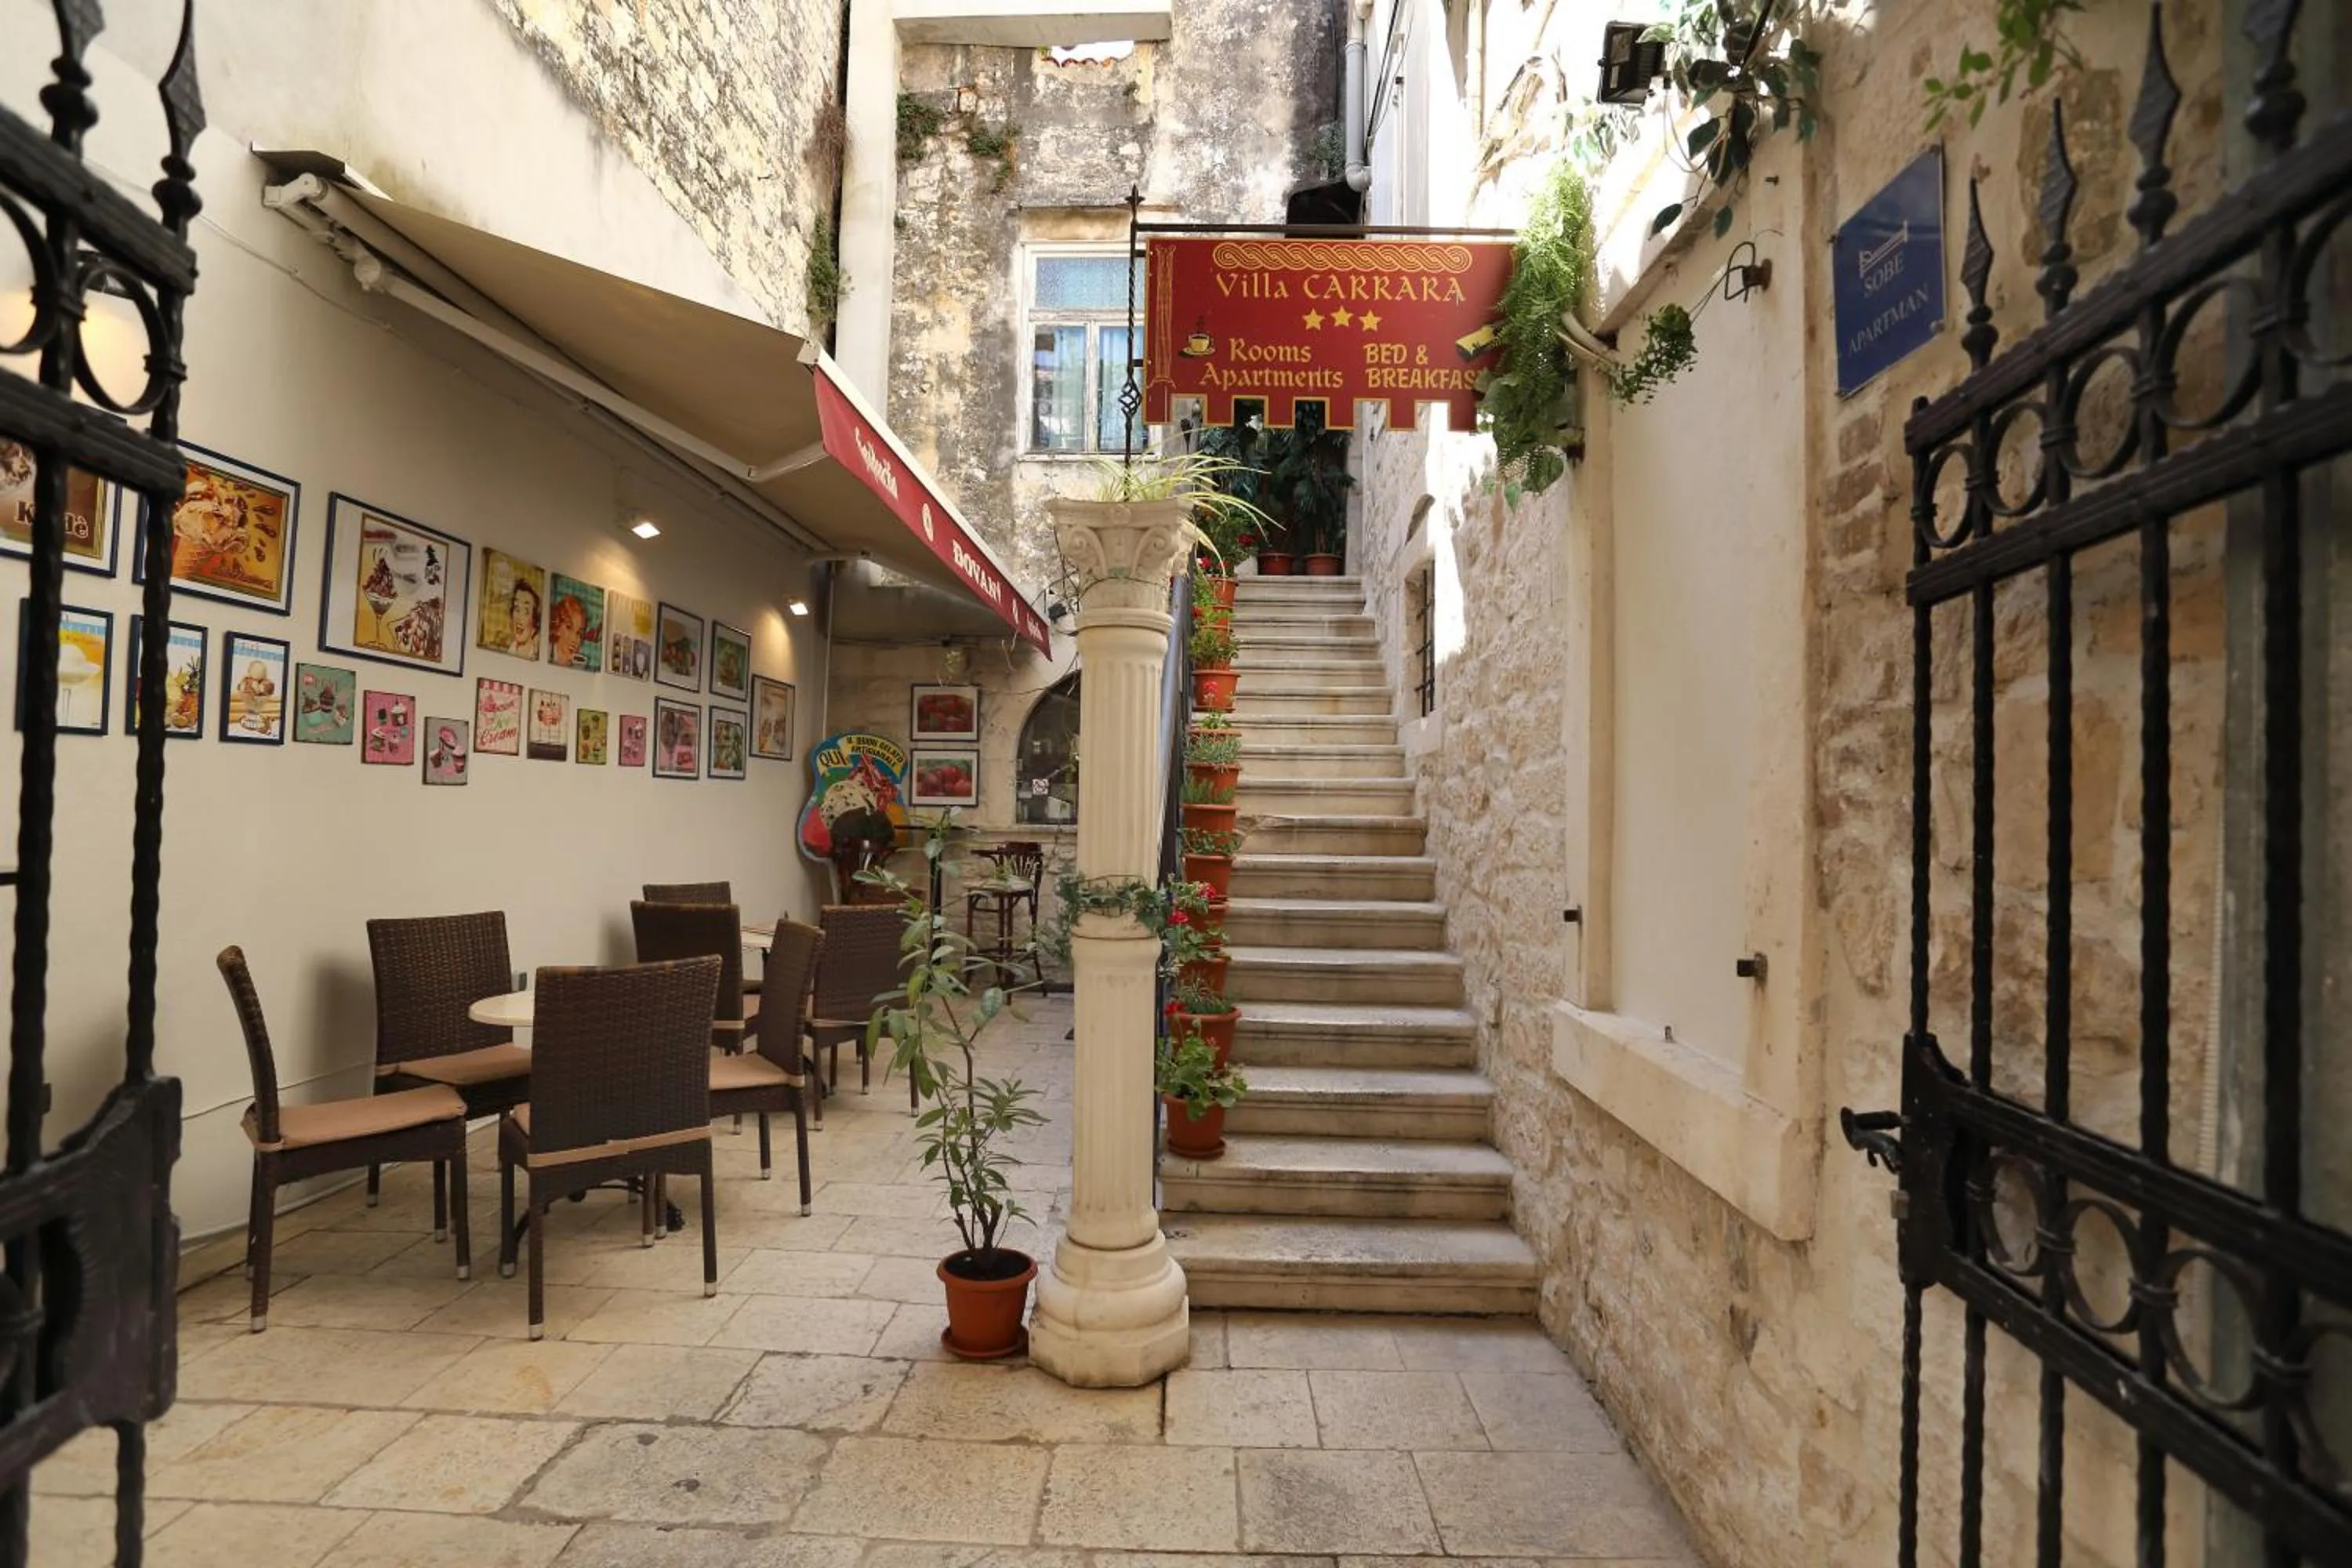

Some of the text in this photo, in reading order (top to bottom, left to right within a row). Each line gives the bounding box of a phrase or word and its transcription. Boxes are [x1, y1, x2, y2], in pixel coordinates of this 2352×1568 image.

[1215, 272, 1467, 303] Villa CARRARA
[1862, 252, 1905, 298] SOBE
[1848, 283, 1930, 357] APARTMAN
[1229, 337, 1312, 364] Rooms
[1364, 343, 1429, 365] BED &
[1198, 361, 1344, 390] Apartments
[1365, 367, 1480, 390] BREAKFAS
